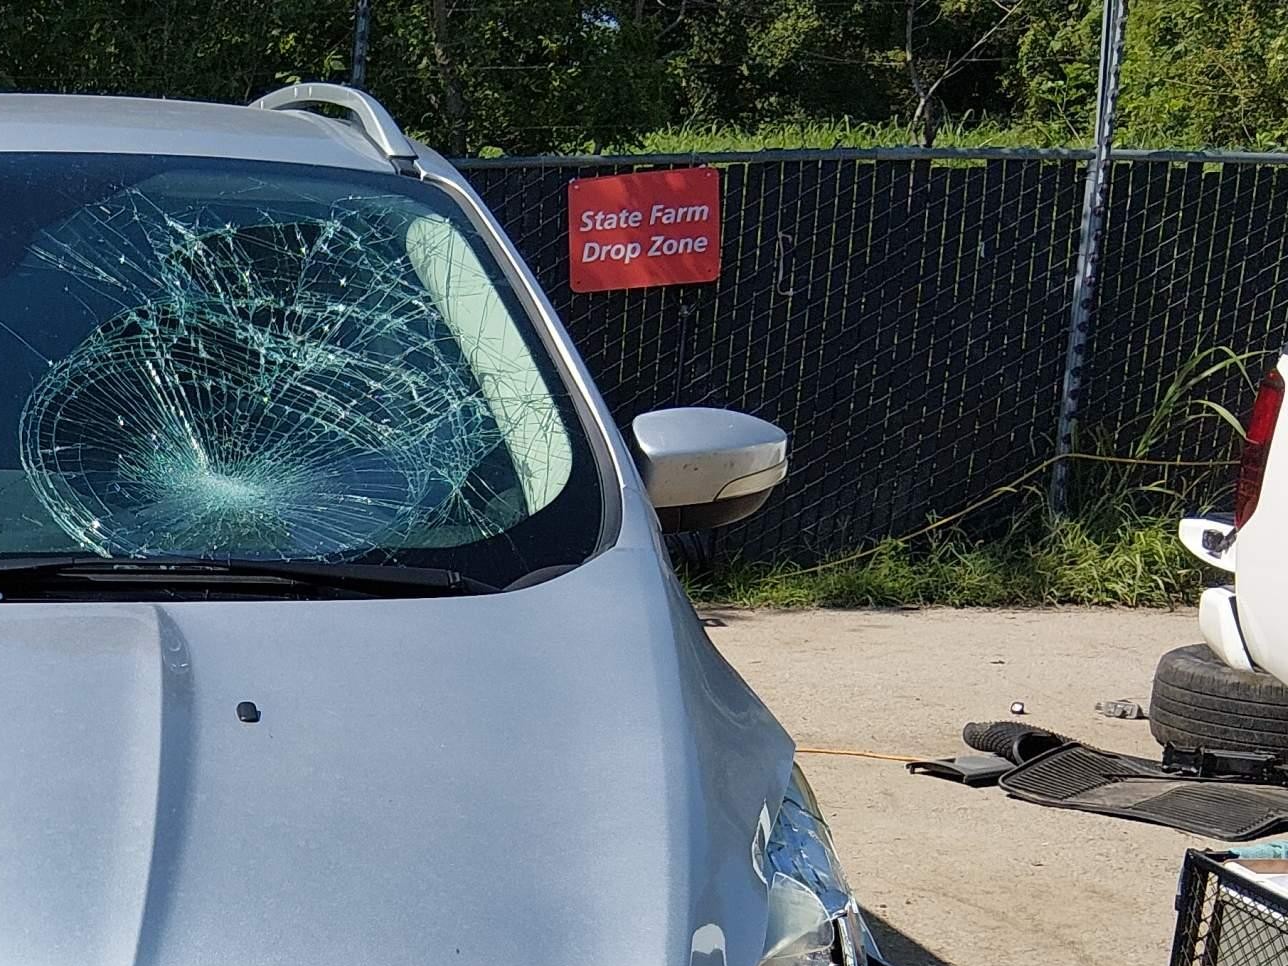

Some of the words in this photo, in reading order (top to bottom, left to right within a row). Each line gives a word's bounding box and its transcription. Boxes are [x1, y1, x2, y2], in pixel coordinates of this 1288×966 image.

[579, 208, 642, 232] State
[649, 204, 709, 226] Farm
[582, 241, 641, 264] Drop
[648, 235, 708, 257] Zone
